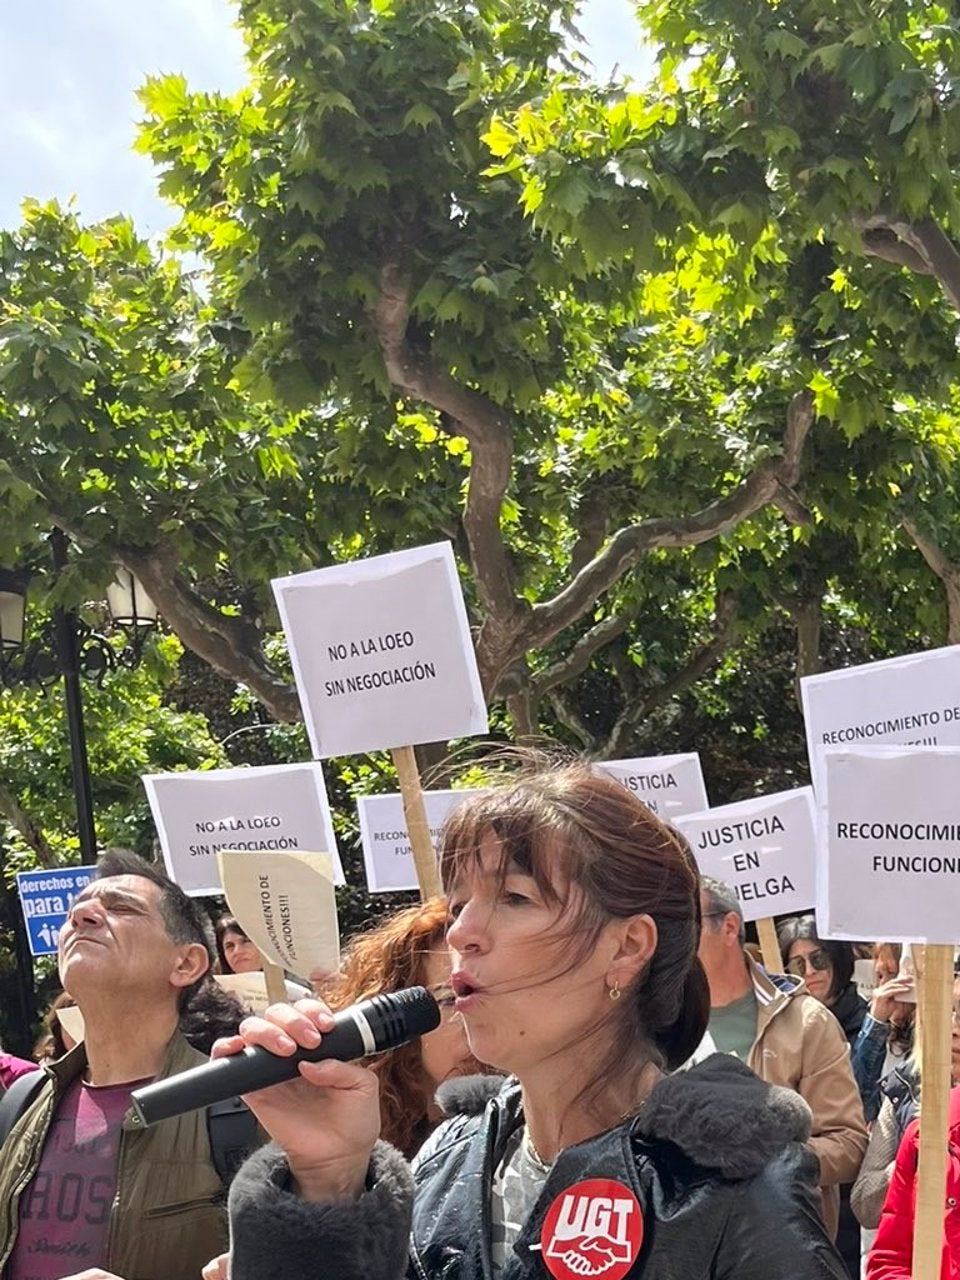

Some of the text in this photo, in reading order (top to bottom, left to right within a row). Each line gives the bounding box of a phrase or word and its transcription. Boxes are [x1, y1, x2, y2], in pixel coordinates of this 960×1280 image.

[328, 631, 414, 661] NO A LA LOEO
[325, 660, 436, 697] SIN NEGOCIACIÓN
[822, 711, 940, 745] RECONOCIMIENTO
[944, 707, 960, 722] DE
[624, 773, 678, 791] STICIA
[195, 816, 281, 833] NO A LA LOEO
[698, 815, 785, 849] JUSTICIA
[189, 844, 210, 856] SIN
[733, 851, 760, 872] EN
[20, 876, 90, 892] derechos en
[259, 874, 269, 890] DE
[734, 876, 795, 901] ELGA
[24, 896, 65, 918] para
[555, 1195, 633, 1242] UGT
